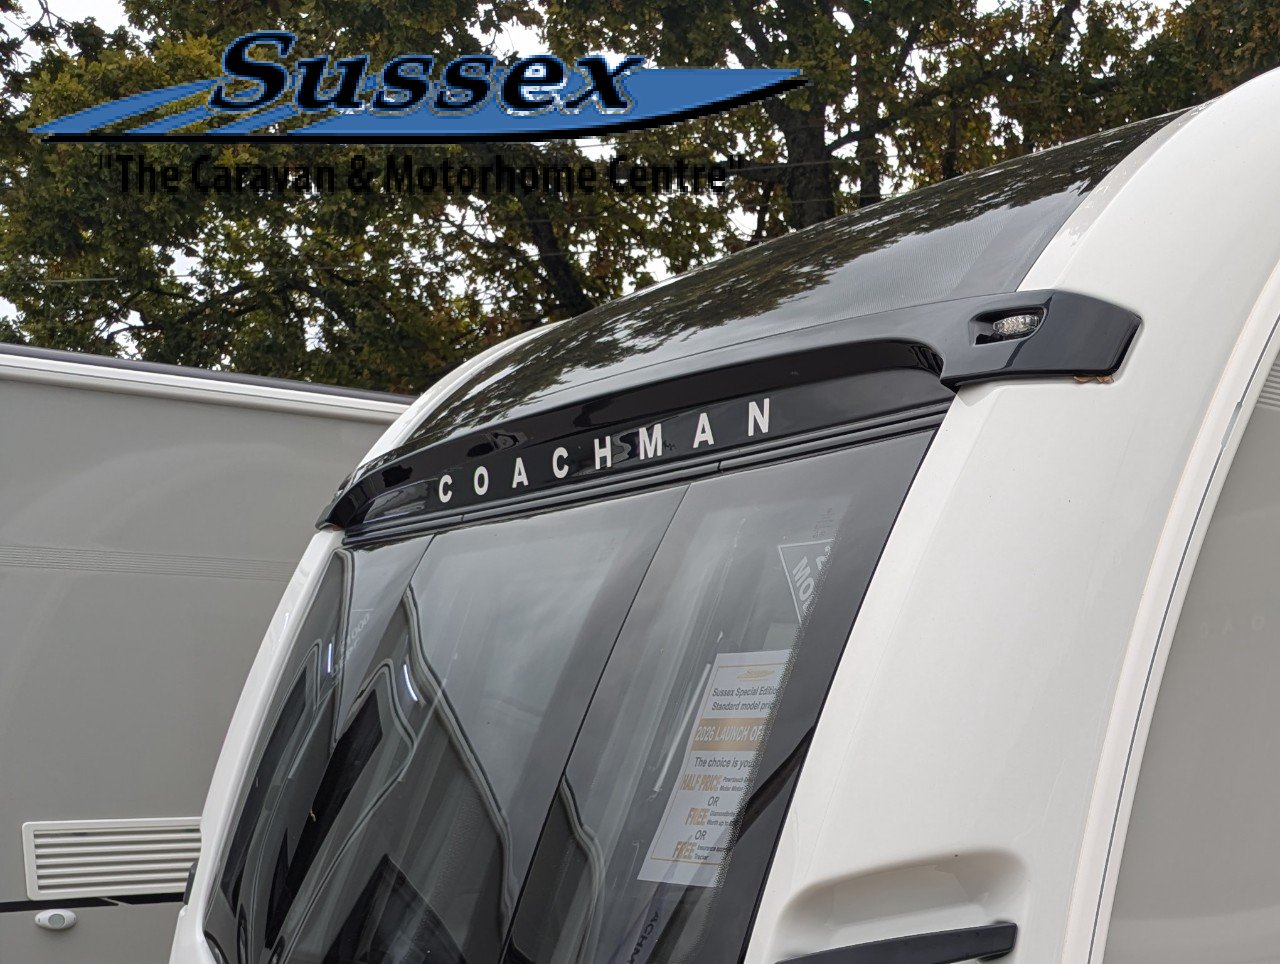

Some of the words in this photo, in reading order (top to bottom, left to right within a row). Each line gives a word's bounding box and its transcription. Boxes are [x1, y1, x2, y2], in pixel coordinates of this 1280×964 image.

[438, 398, 770, 503] COACHMAN
[712, 687, 735, 697] Sussex
[735, 686, 759, 698] Special
[711, 701, 740, 711] Standard
[740, 700, 760, 711] model
[695, 726, 716, 741] 2026
[715, 726, 750, 741] LAUNCH
[694, 757, 708, 768] The
[708, 757, 731, 768] choice
[707, 796, 720, 807] OR
[685, 807, 710, 826] FREE
[694, 829, 708, 840] OR
[672, 841, 698, 859] FREE
